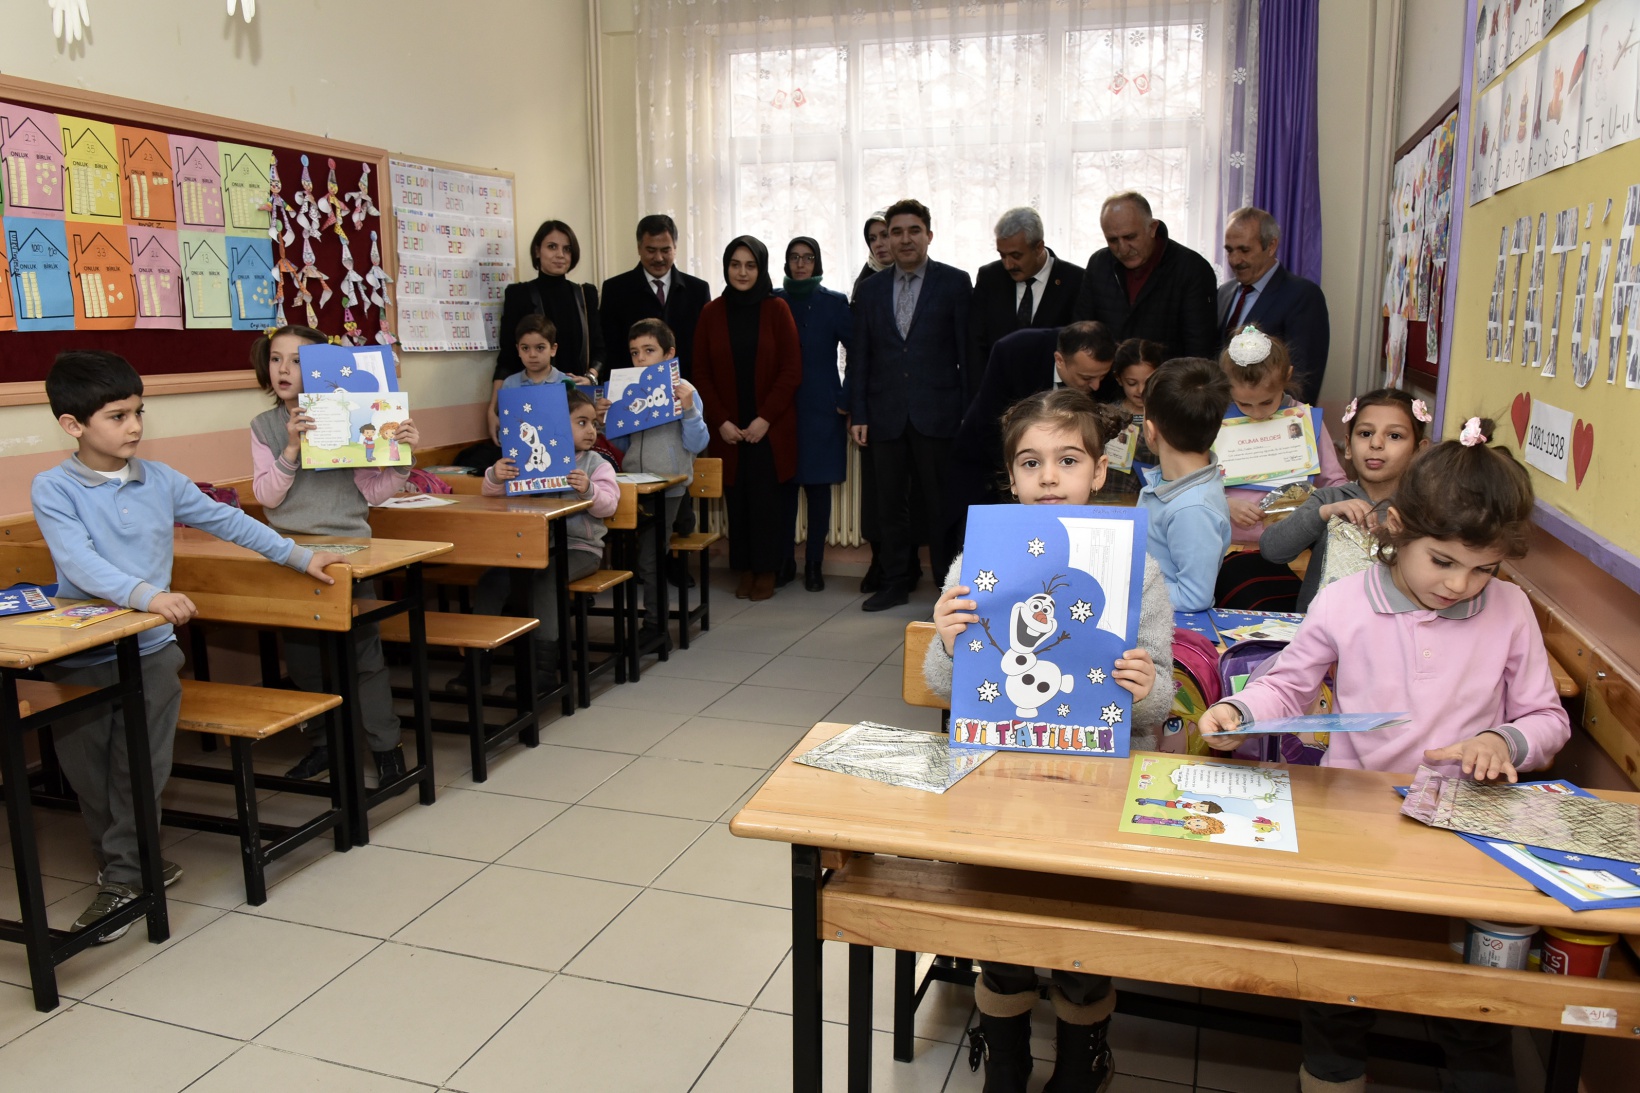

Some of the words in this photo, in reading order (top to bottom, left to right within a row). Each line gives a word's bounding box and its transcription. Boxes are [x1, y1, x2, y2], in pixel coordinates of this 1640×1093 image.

[1586, 116, 1605, 150] T-t
[1609, 104, 1630, 140] U-u
[402, 190, 423, 206] 2020
[485, 202, 502, 215] 22
[403, 236, 424, 251] 2020
[405, 281, 425, 295] 2020
[449, 284, 467, 297] 2020
[409, 325, 429, 339] 2020
[452, 326, 471, 339] 2020
[1237, 437, 1259, 446] OKUMA
[1528, 425, 1565, 460] 1881-1938
[526, 477, 568, 491] TATİLLE
[995, 719, 1113, 751] TATİLLER
